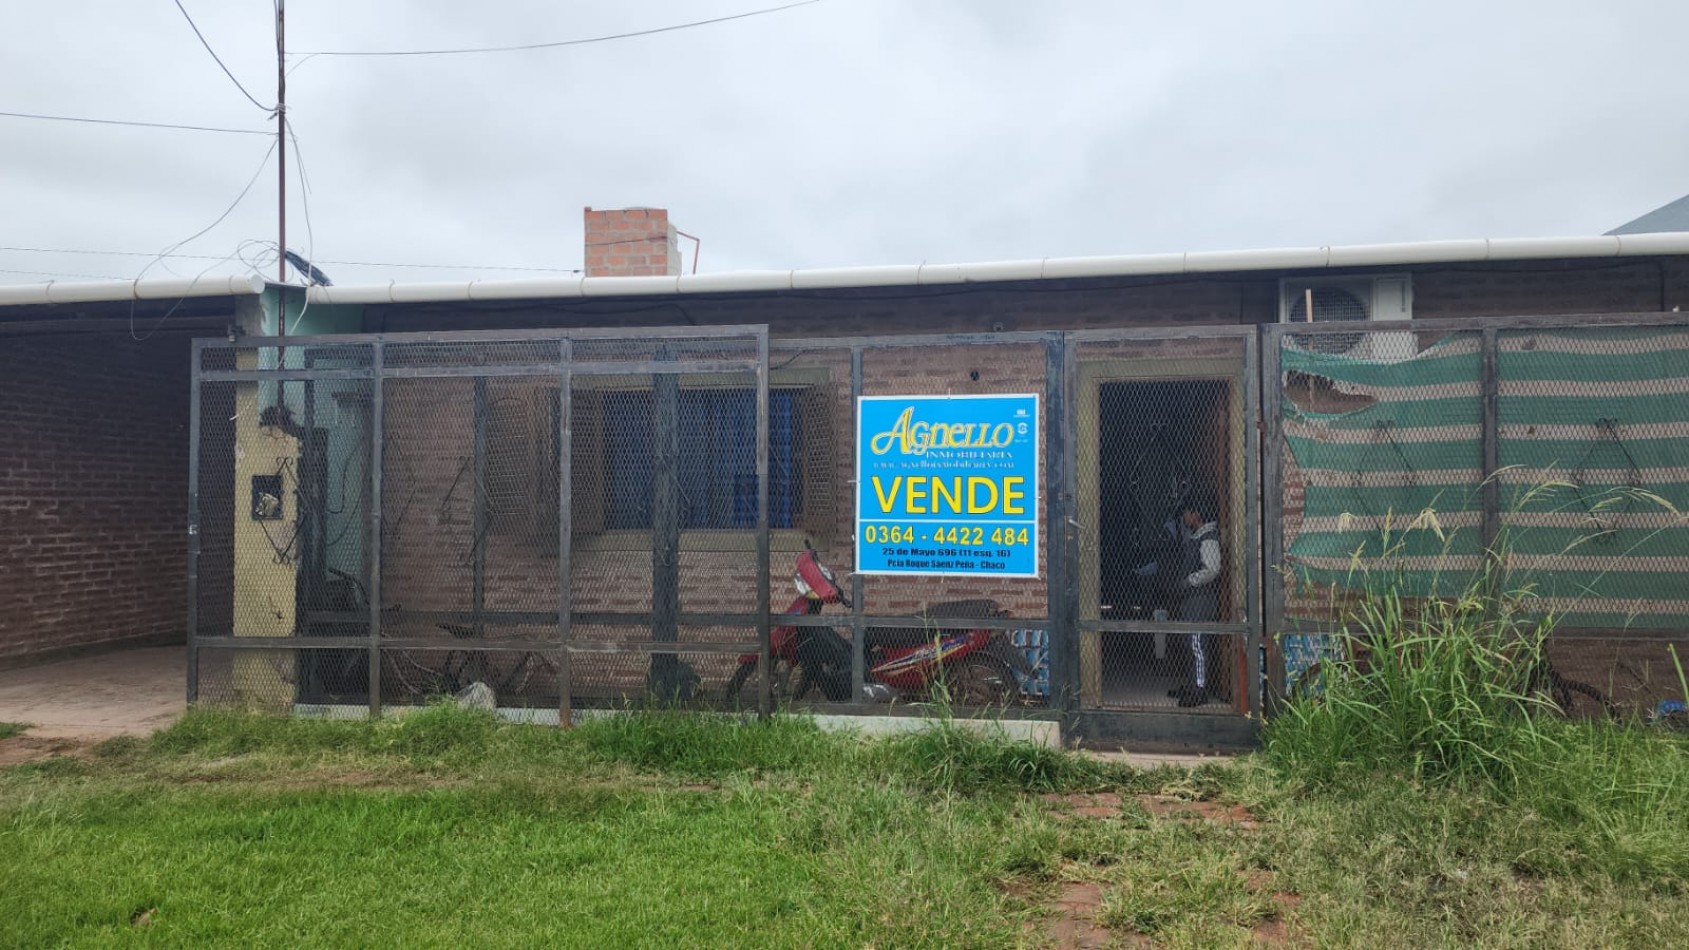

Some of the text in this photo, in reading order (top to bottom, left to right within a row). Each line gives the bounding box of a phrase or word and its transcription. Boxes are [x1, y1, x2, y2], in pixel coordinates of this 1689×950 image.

[871, 475, 1025, 515] VENDE
[865, 525, 914, 544] 0364
[933, 526, 983, 546] 4422
[990, 527, 1029, 547] 484
[882, 547, 894, 556] 25
[896, 548, 909, 556] de
[910, 548, 936, 558] Mayo
[938, 548, 957, 557] 696
[996, 549, 1011, 558] 16)
[905, 559, 929, 569] Roque
[980, 561, 1006, 570] Chaco
